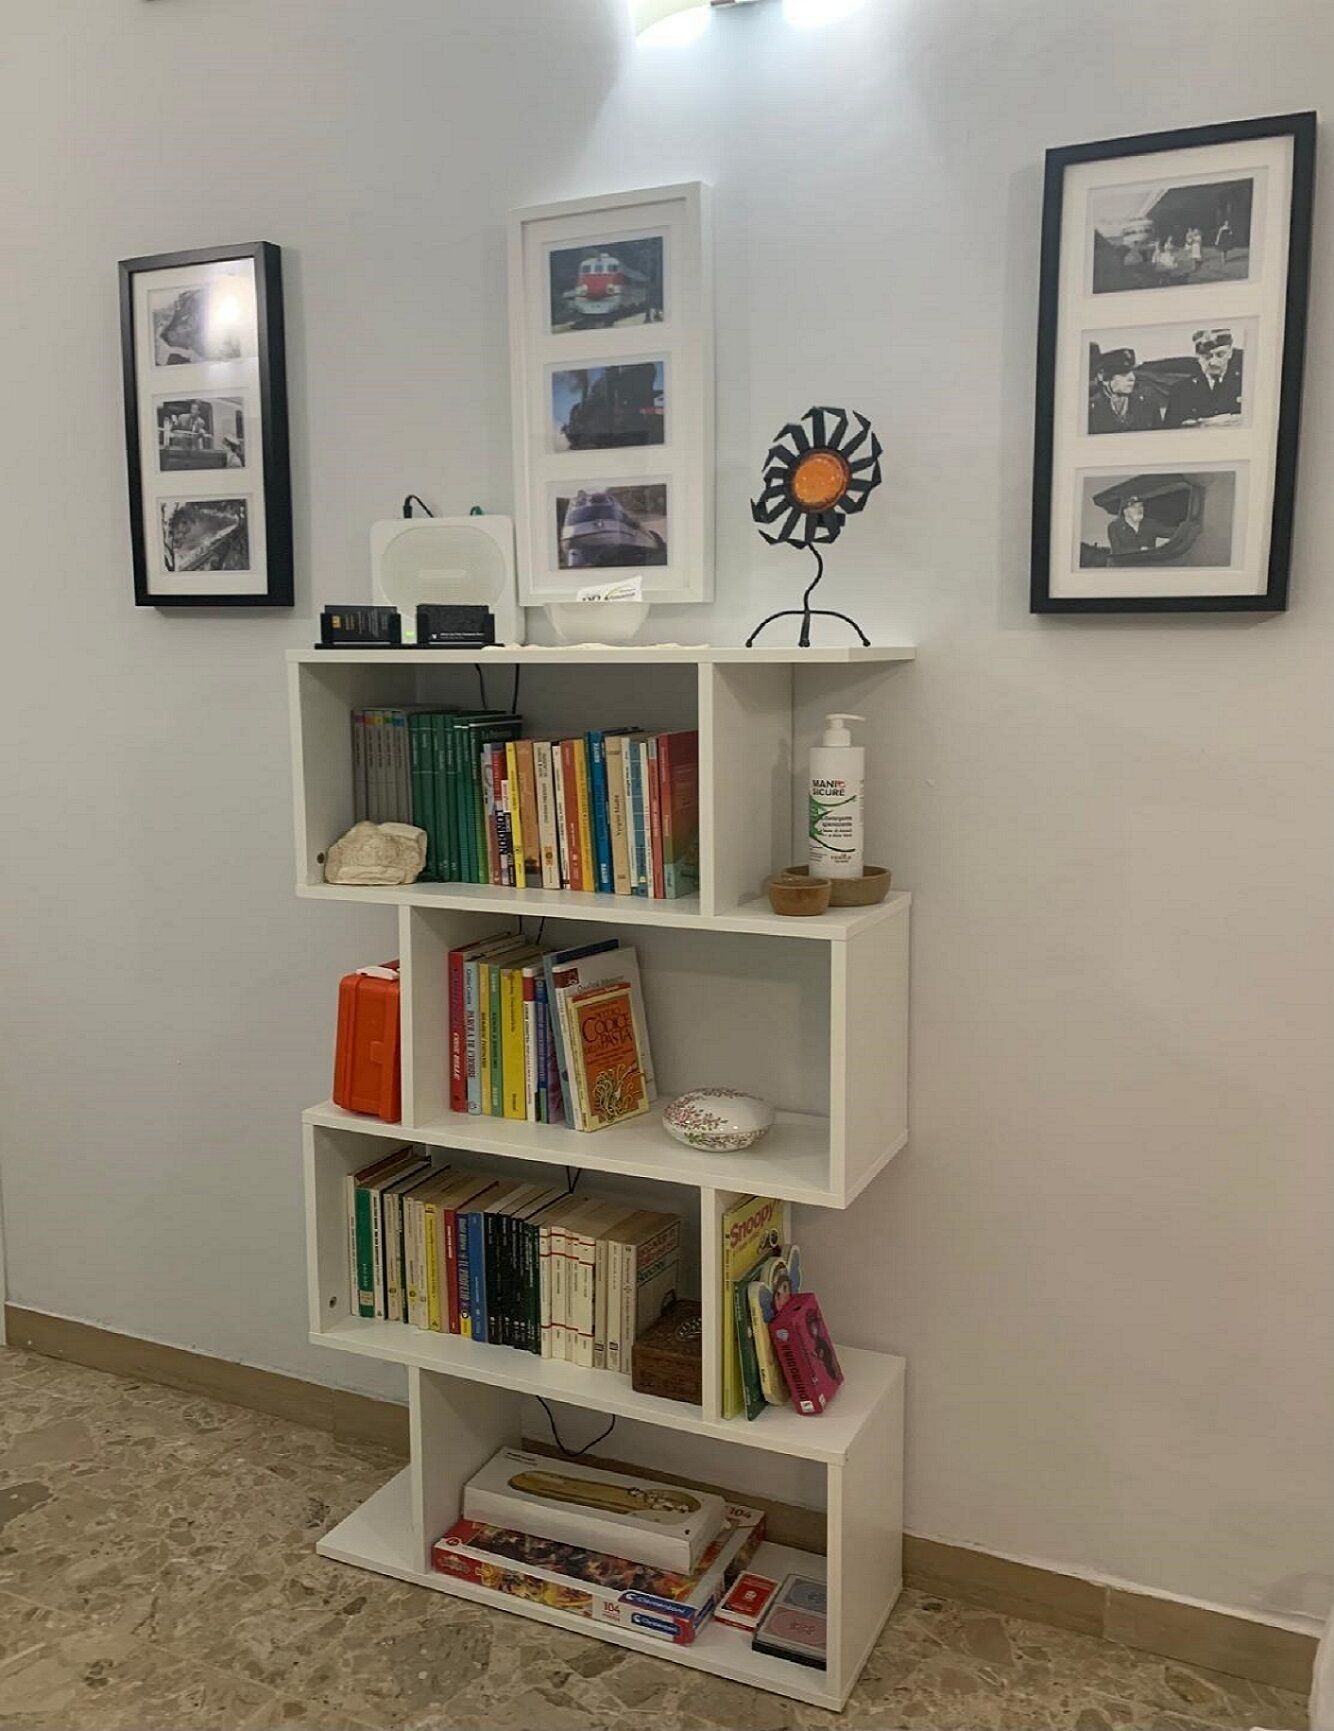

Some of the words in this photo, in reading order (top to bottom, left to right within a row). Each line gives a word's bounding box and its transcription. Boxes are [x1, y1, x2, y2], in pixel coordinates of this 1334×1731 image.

[812, 788, 845, 797] SICURE
[495, 809, 508, 856] LONDON
[730, 1203, 774, 1248] Snoopy
[728, 1505, 752, 1519] 104
[602, 1601, 620, 1614] 104
